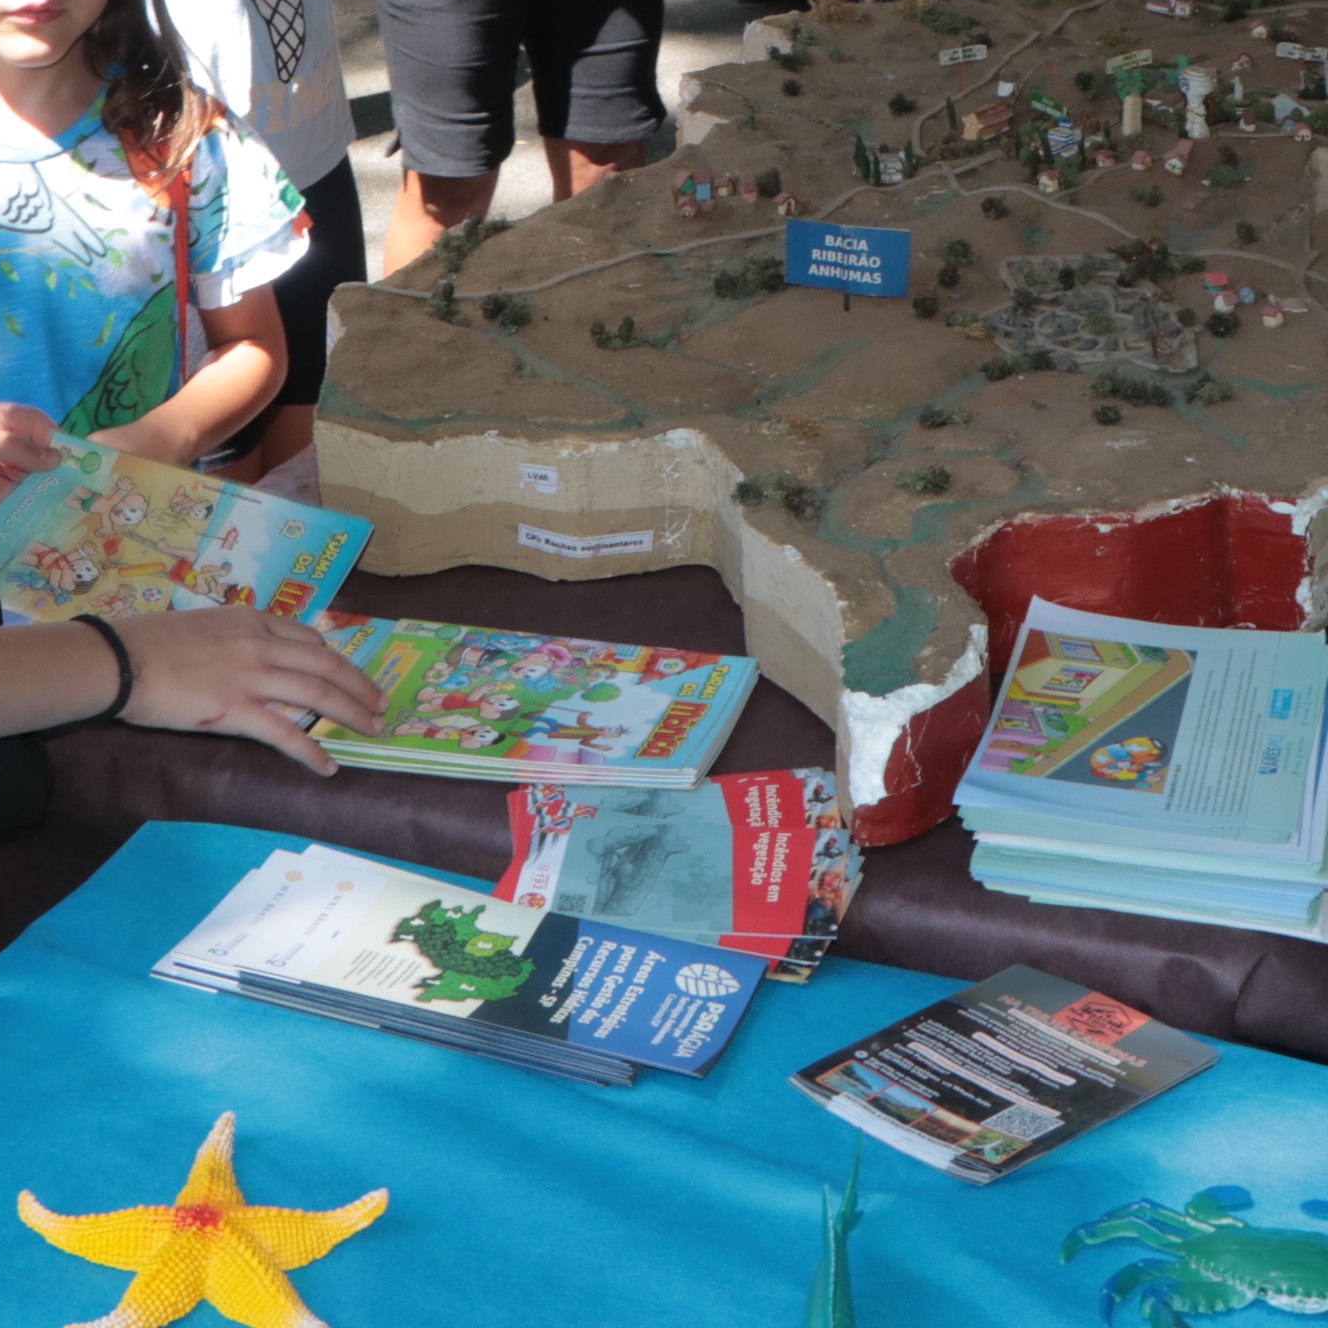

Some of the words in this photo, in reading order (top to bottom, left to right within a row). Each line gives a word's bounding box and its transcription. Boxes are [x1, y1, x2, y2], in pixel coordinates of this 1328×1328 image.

[824, 234, 869, 252] BACIA
[811, 248, 881, 269] RIBEIRÃO
[808, 263, 883, 285] ANHUMAS
[5, 475, 59, 527] Salvando
[311, 533, 349, 580] TURMA
[544, 537, 577, 552] Rochas
[292, 554, 315, 575] DA
[341, 627, 377, 657] TURM
[678, 683, 699, 696] DA
[699, 665, 730, 699] TURMA
[744, 785, 765, 827] vegetaçã
[749, 832, 770, 885] vegetação
[770, 833, 792, 884] Incêndios
[766, 884, 780, 902] em
[446, 910, 462, 919] 2
[477, 940, 493, 950] 3
[613, 945, 637, 974] para
[551, 936, 595, 989] Campinas
[577, 940, 618, 989] Recursos
[632, 950, 667, 985] Áreas
[459, 984, 476, 992] 2
[538, 994, 558, 1008] SP
[590, 974, 623, 1009] Gestão
[549, 988, 589, 1024] Hídricos
[578, 1009, 601, 1024] dos
[593, 984, 645, 1039] Estratégicas
[1023, 1005, 1069, 1033] TRILHA
[1070, 1030, 1147, 1067] CAMPINAS
